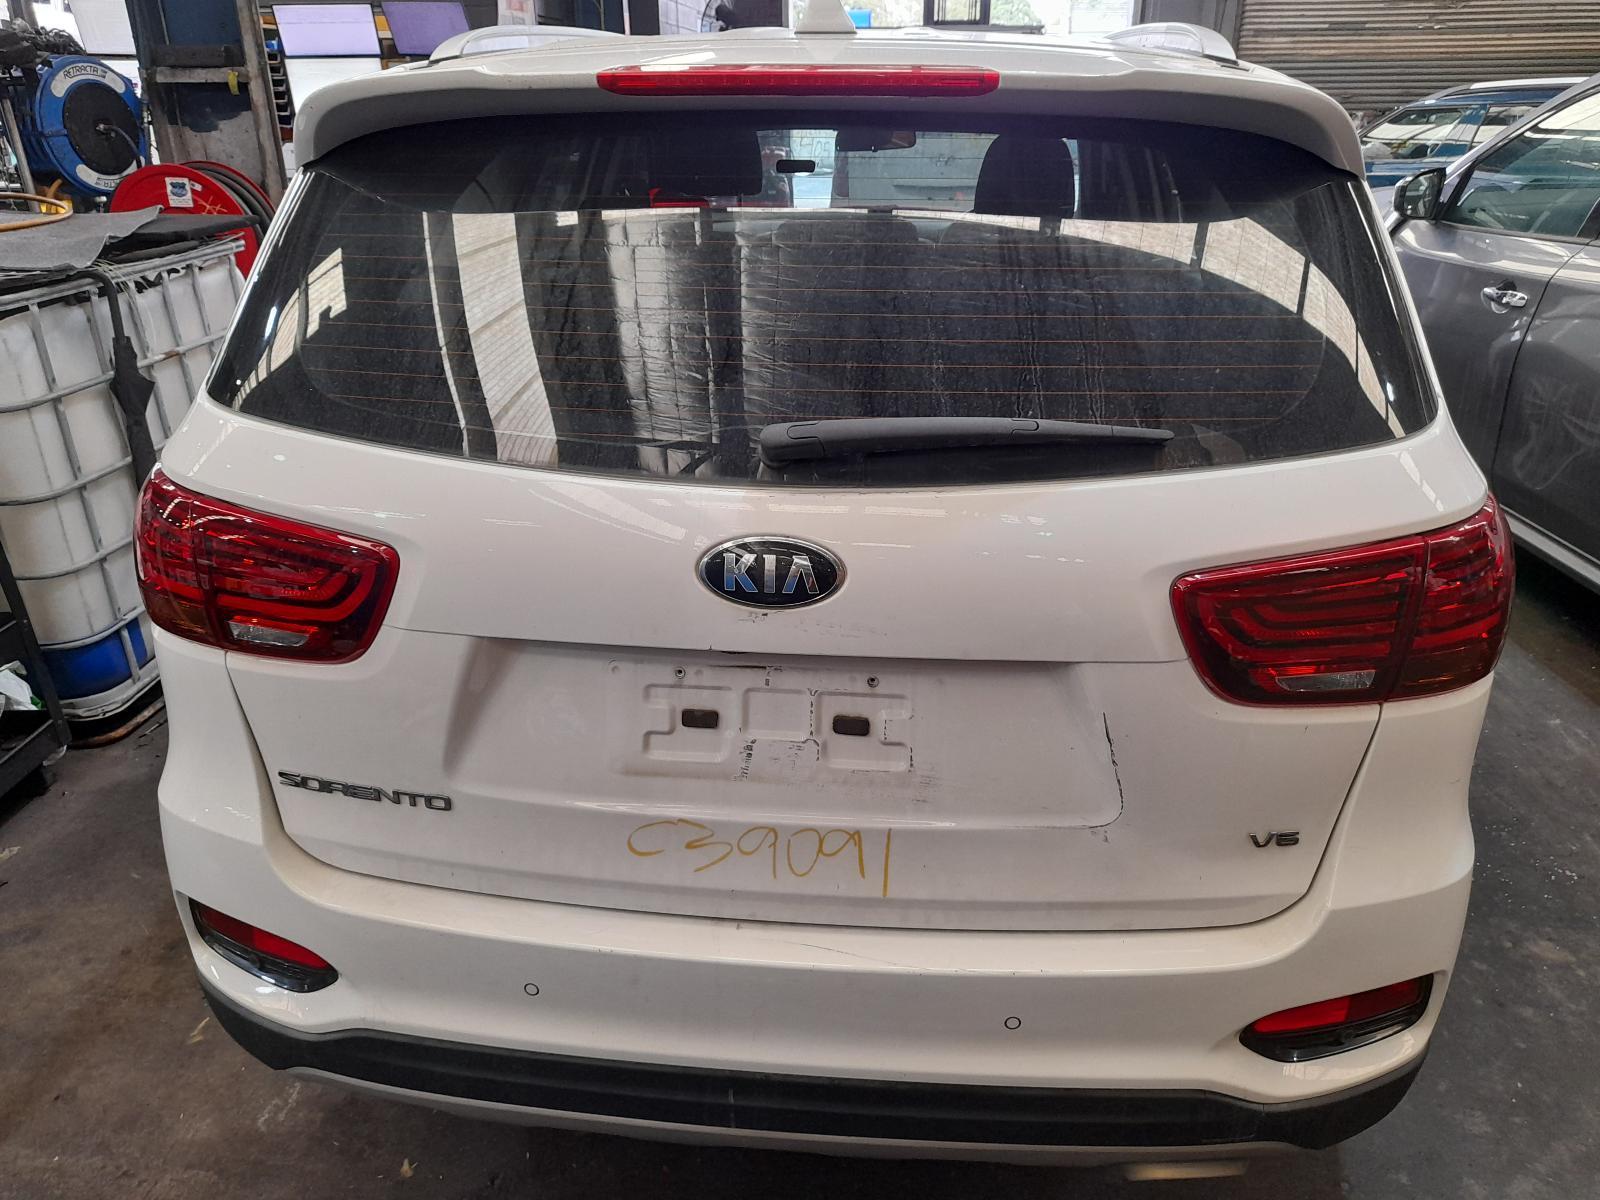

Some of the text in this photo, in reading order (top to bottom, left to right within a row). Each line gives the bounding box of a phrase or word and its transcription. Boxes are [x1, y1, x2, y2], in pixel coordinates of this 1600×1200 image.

[63, 65, 99, 79] RETRACTA
[723, 553, 820, 593] KIA
[278, 770, 453, 811] SORENTO
[627, 818, 892, 897] C39091
[1249, 831, 1300, 848] V6
